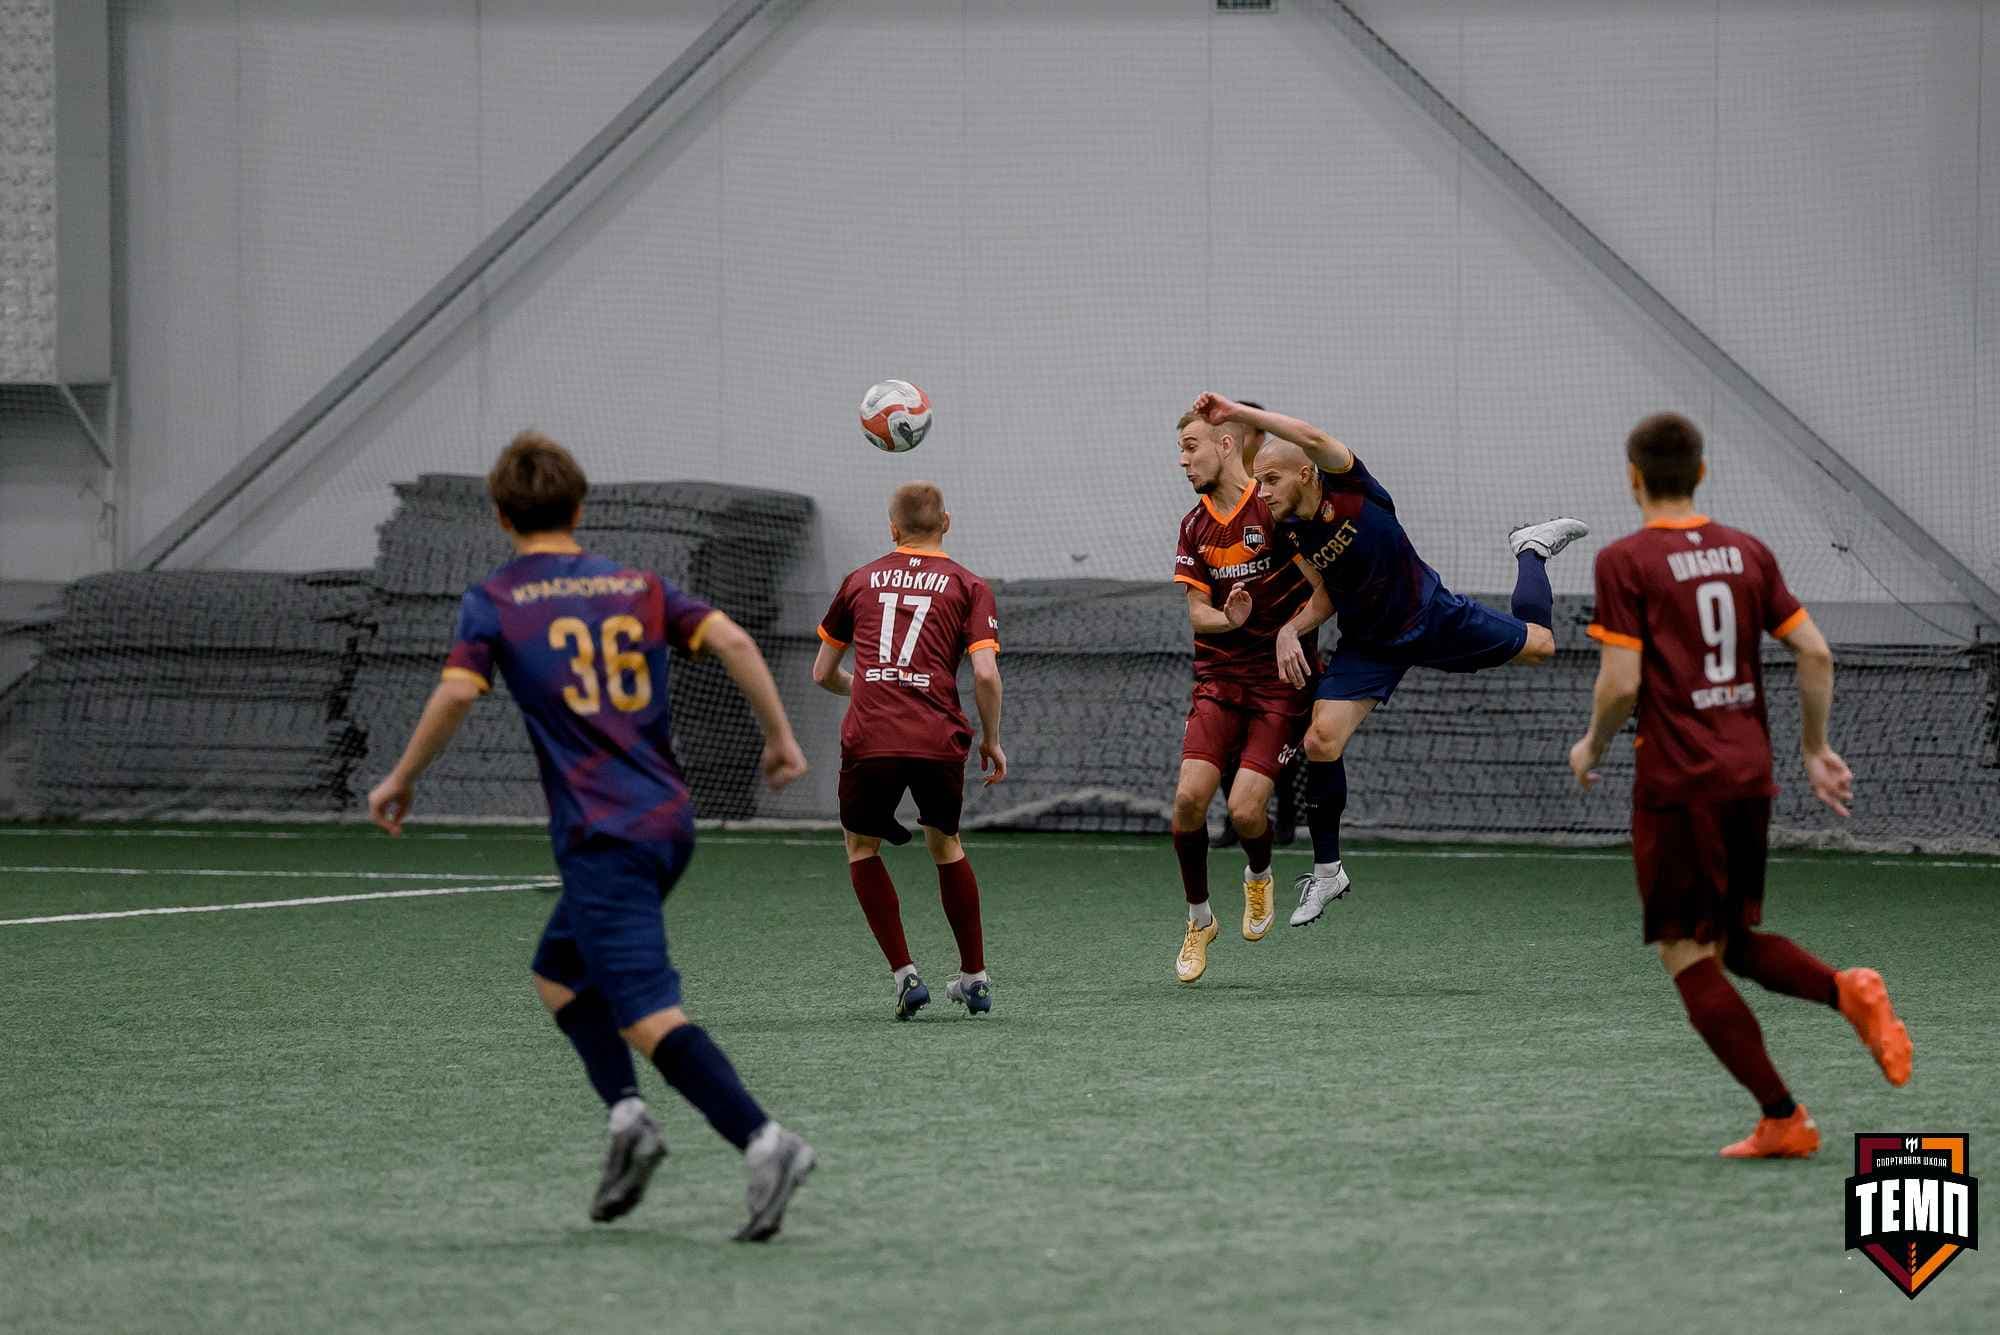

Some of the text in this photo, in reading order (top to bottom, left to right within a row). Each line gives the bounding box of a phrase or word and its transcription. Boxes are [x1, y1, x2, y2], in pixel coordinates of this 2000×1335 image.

[870, 568, 950, 594] КУЗЬКИН
[548, 614, 652, 715] 36
[878, 592, 932, 667] 17
[1695, 581, 1738, 684] 9
